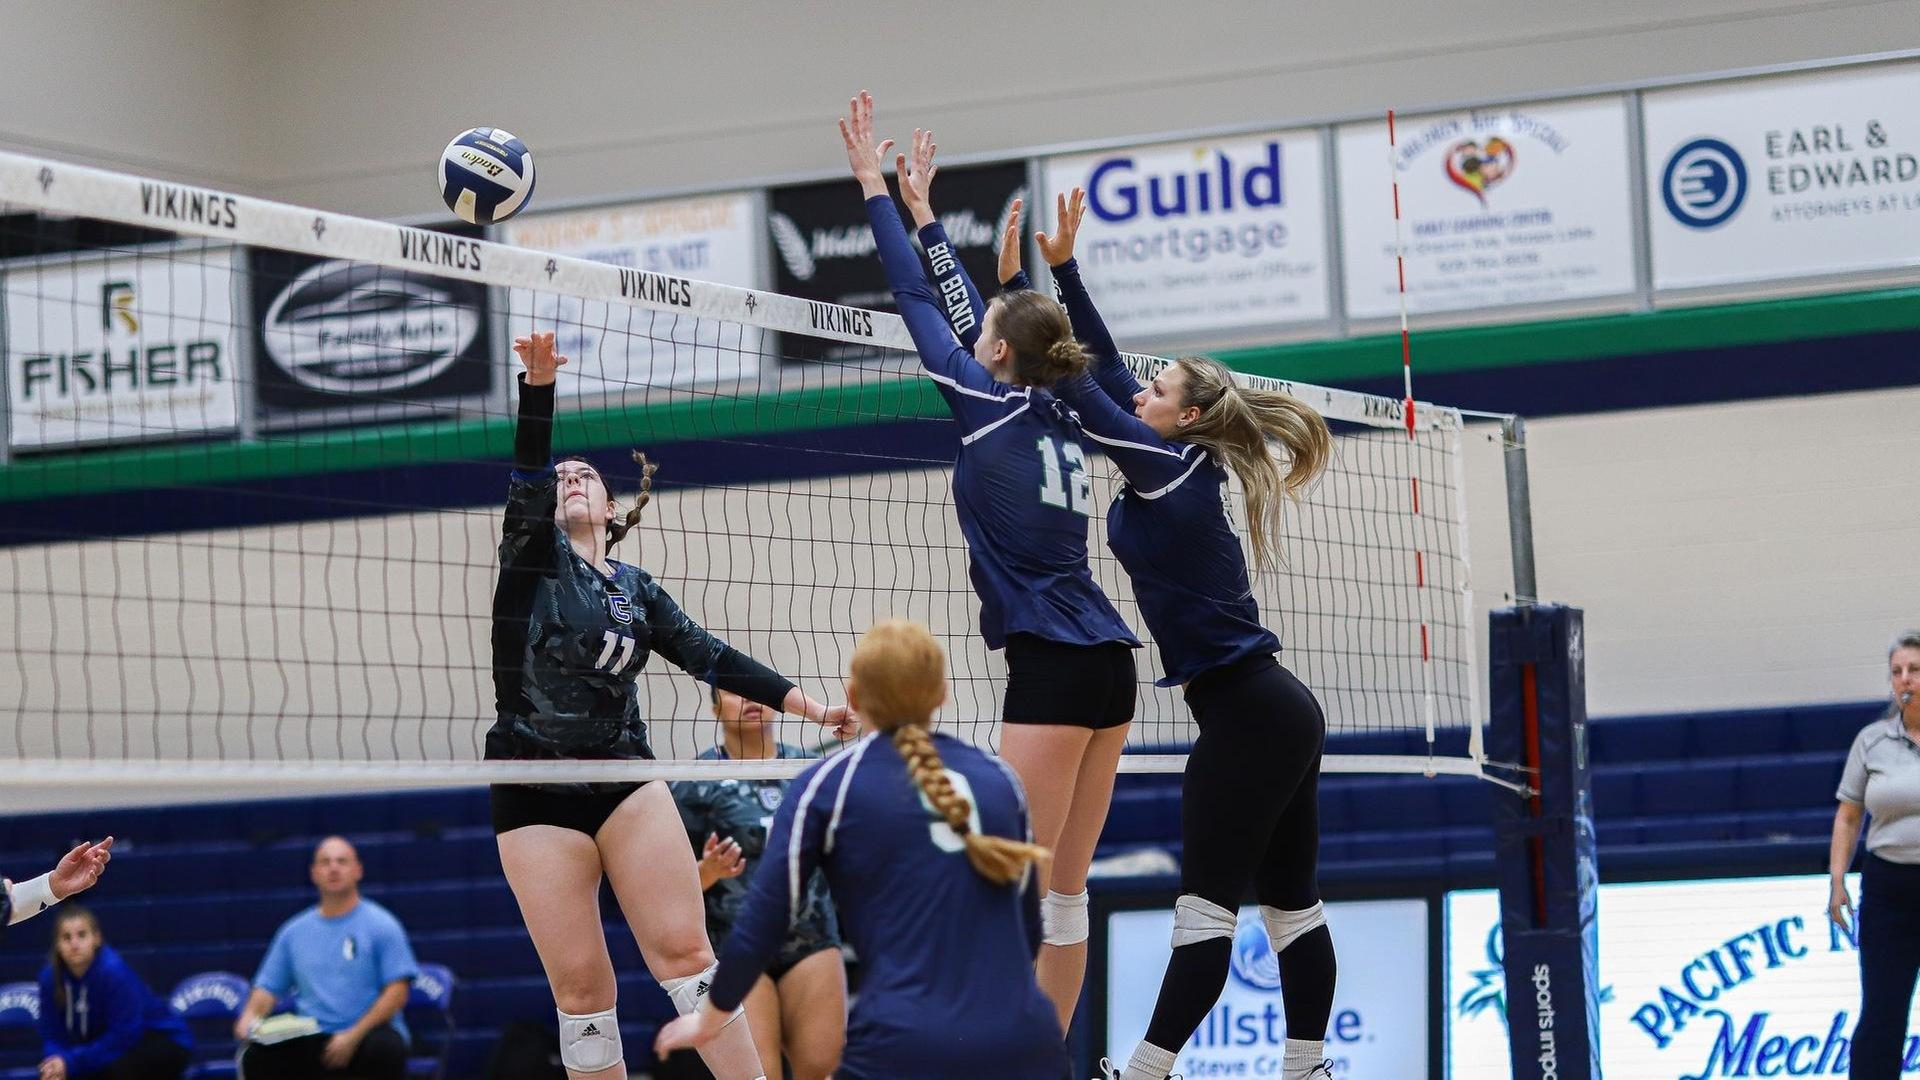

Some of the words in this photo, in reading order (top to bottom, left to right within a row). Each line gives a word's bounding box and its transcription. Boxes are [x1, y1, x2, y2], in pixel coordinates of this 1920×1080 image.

[1765, 124, 1853, 159] EARL
[1866, 119, 1889, 149] &
[461, 151, 504, 177] Baden
[1088, 142, 1283, 223] Guild
[141, 182, 237, 229] VIKINGS
[399, 228, 481, 271] VIKINGS
[926, 241, 956, 277] BIG
[1087, 222, 1288, 264] mortgage
[619, 268, 691, 308] VIKINGS
[939, 273, 977, 336] BEND
[808, 301, 873, 338] VIKINGS
[23, 341, 222, 398] FISHER
[1037, 435, 1090, 517] 12
[594, 630, 636, 676] 11
[1629, 915, 1809, 1049] PACIFIC
